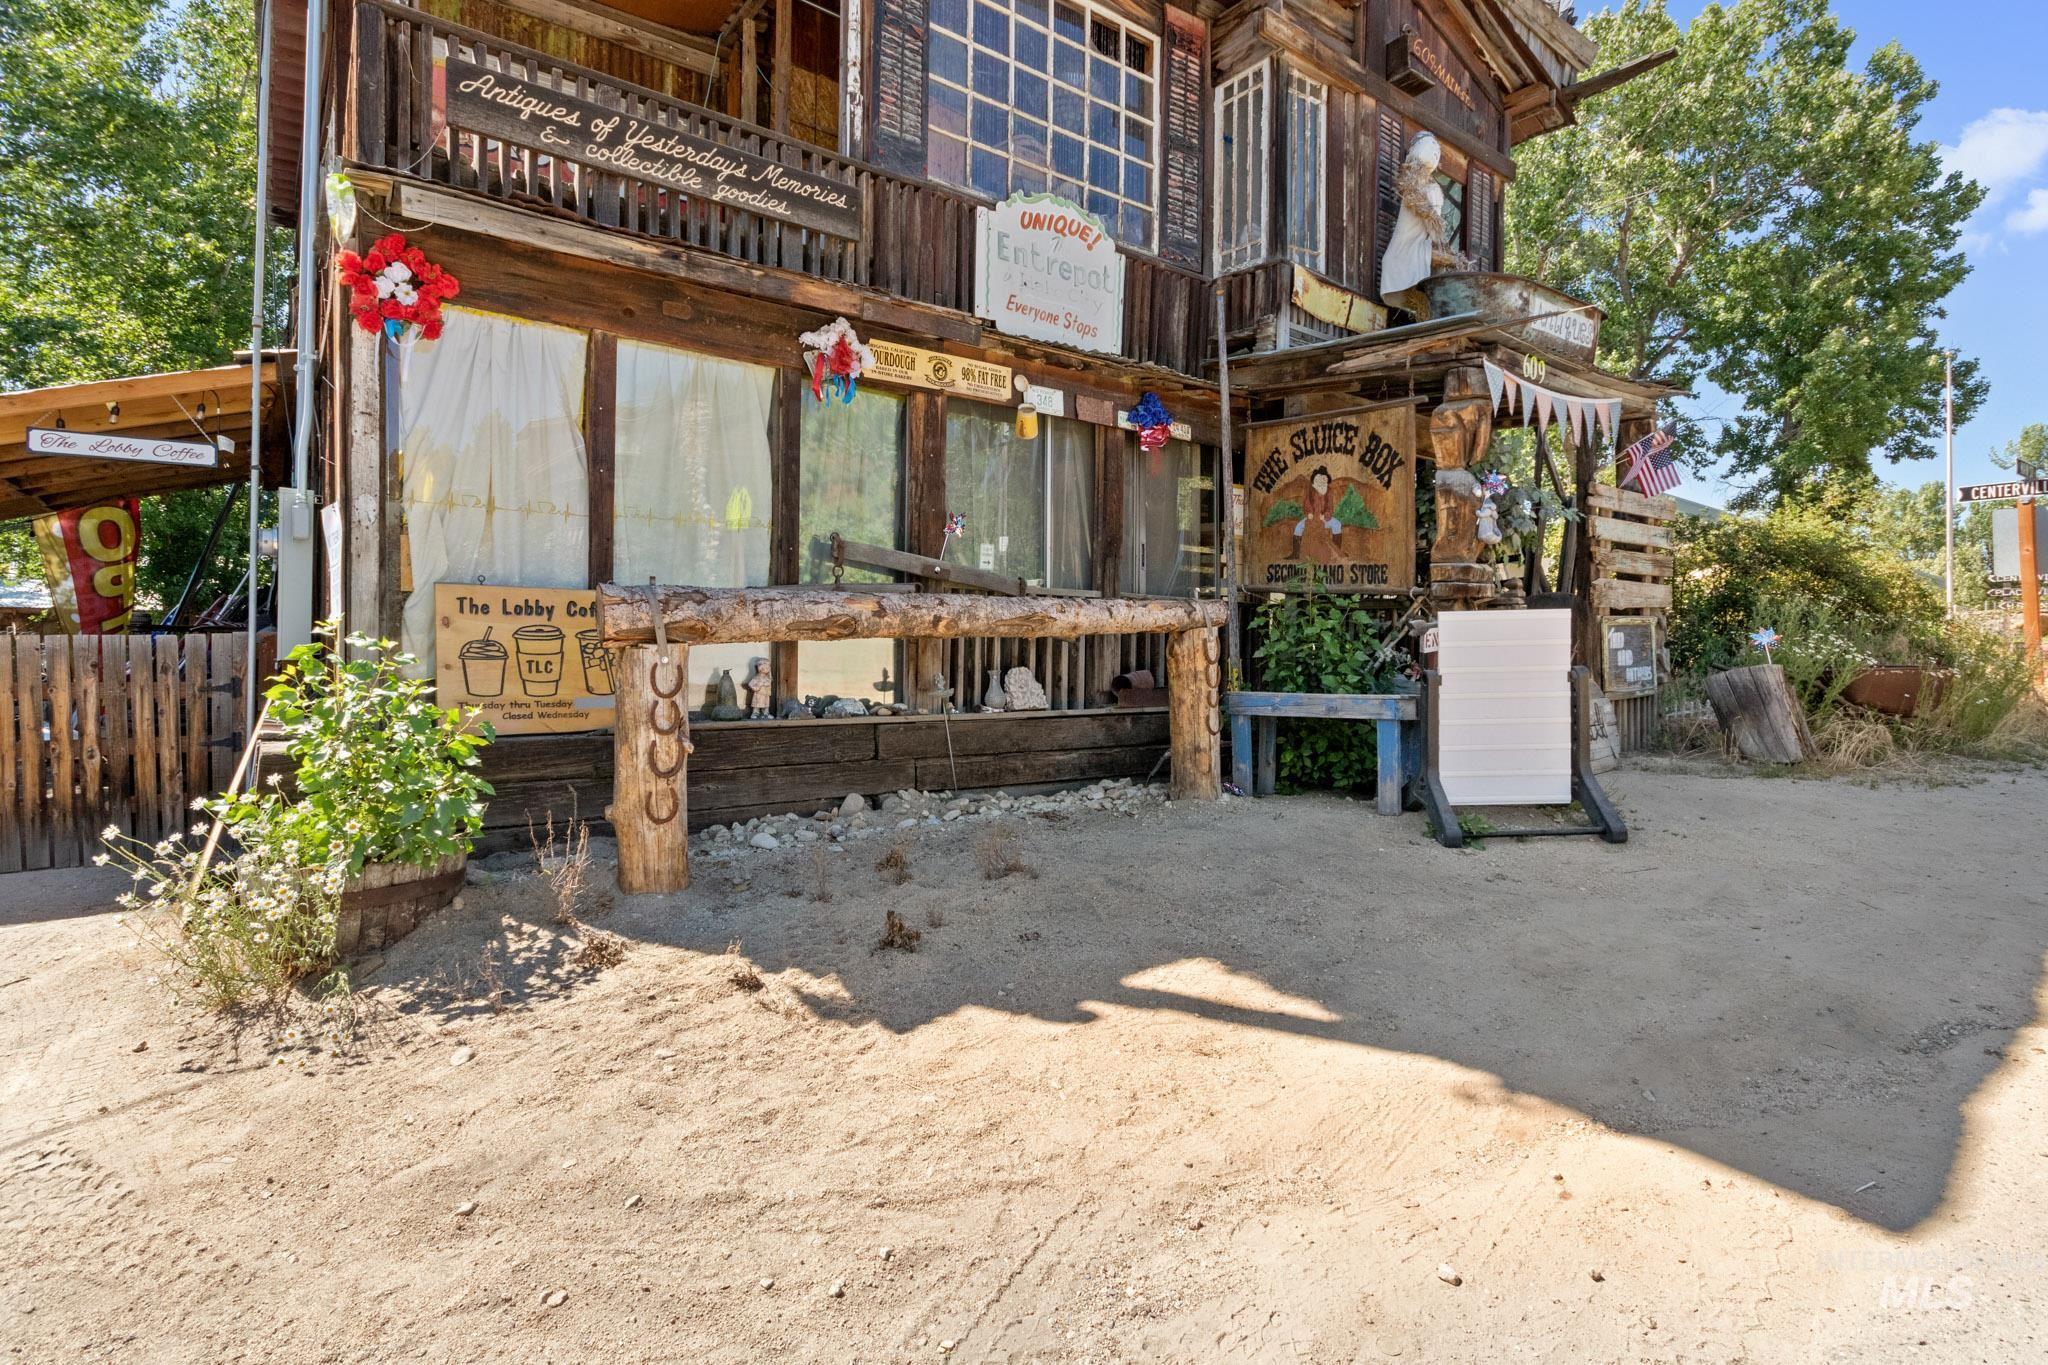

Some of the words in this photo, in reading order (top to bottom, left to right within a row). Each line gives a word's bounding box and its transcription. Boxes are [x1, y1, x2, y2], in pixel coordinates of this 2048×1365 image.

[459, 74, 581, 127] Antiques
[591, 116, 620, 142] of
[623, 120, 747, 182] Yesterday's
[751, 164, 848, 209] Memories
[540, 126, 570, 144] &
[586, 144, 702, 189] collectible
[712, 183, 791, 215] goodies
[1020, 210, 1103, 251] UNIQUE!
[1006, 294, 1060, 326] Everyone
[1063, 312, 1098, 339] Stops
[961, 366, 977, 383] 98%
[977, 370, 990, 385] FAT
[990, 373, 1006, 389] FREE
[1523, 353, 1545, 384] 609
[40, 432, 78, 449] The
[88, 438, 144, 458] Lobby
[152, 443, 206, 461] Coffee
[1252, 447, 1289, 494] THE
[1290, 421, 1359, 464] SLUICE
[1359, 431, 1405, 490] BOX
[1350, 563, 1389, 584] STORE
[456, 596, 491, 615] The
[502, 598, 555, 622] Lobby
[567, 600, 598, 618] Cof
[525, 659, 553, 674] TLC
[502, 711, 534, 720] Closed
[537, 711, 590, 720] Wednesday
[510, 701, 531, 709] thru
[534, 700, 573, 710] Tuesday
